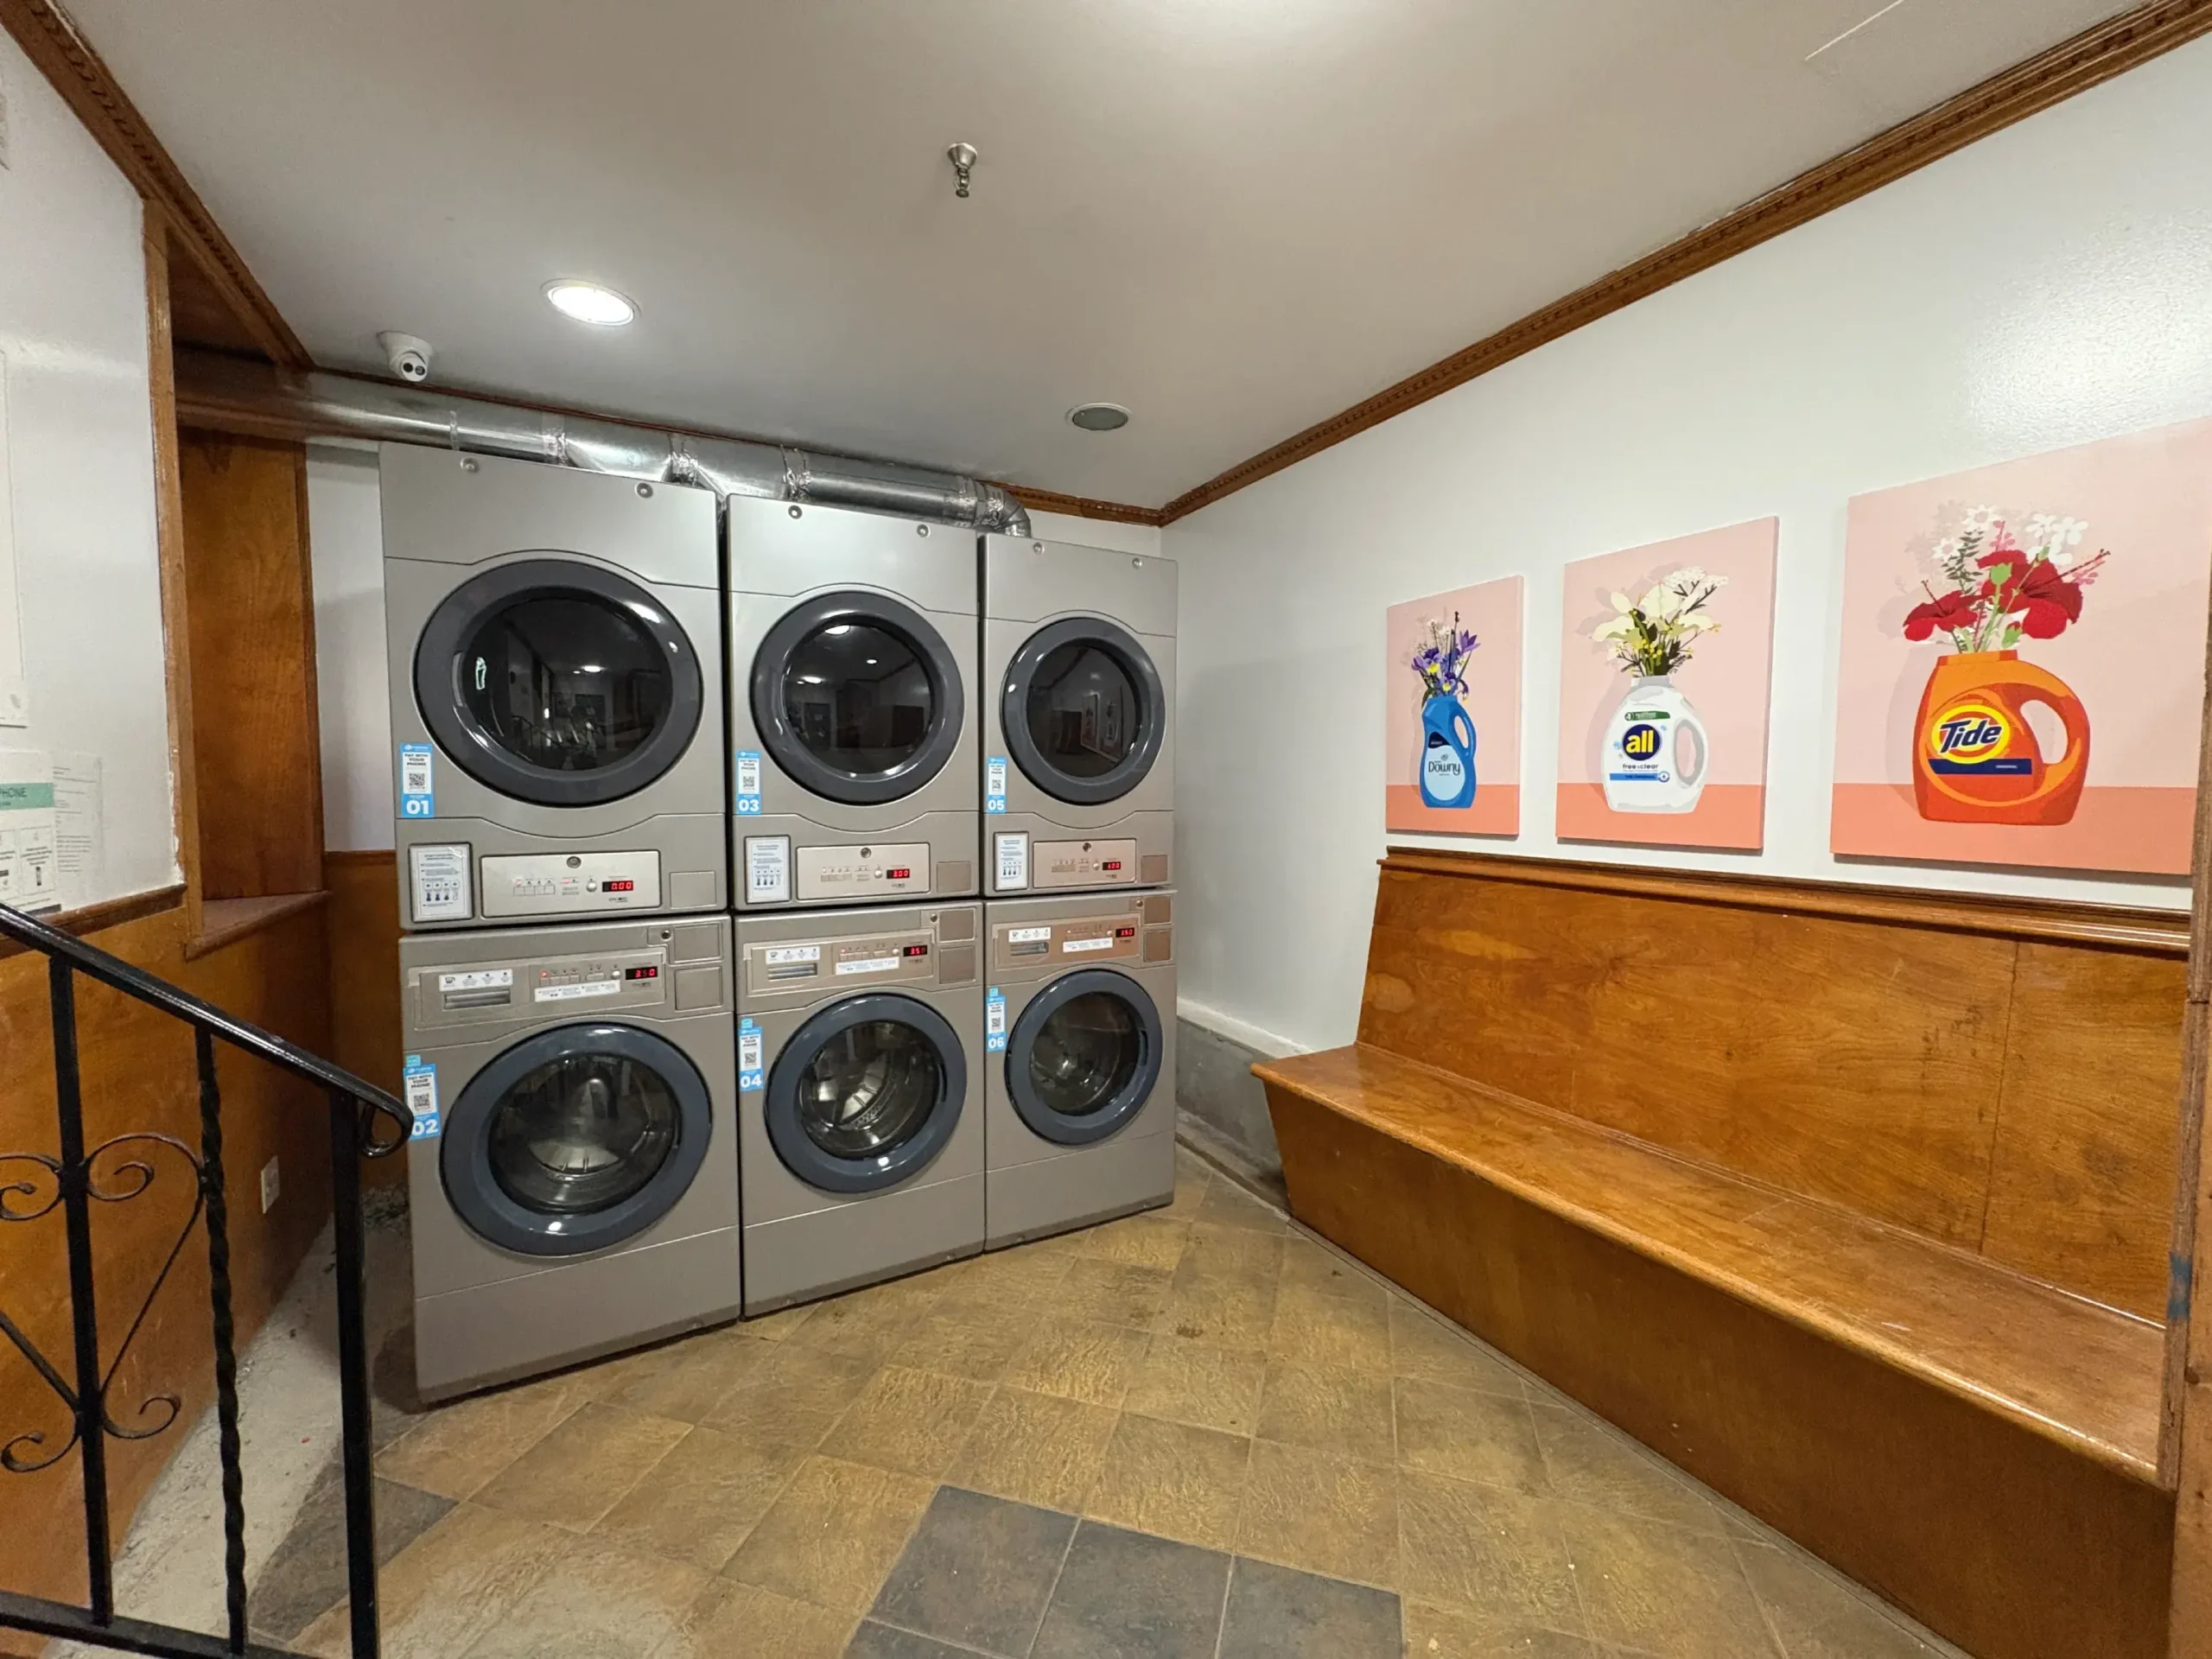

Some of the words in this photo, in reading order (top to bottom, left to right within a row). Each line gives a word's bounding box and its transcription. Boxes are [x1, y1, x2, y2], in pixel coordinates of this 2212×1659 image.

[1625, 729, 1655, 753] all
[1940, 719, 2003, 753] Tide
[1428, 761, 1461, 776] Downy
[406, 799, 429, 815] 01
[738, 798, 760, 812] 03
[988, 798, 1005, 811] 05
[988, 1036, 1005, 1049] 06
[740, 1074, 762, 1088] 04
[411, 1119, 439, 1136] 02
